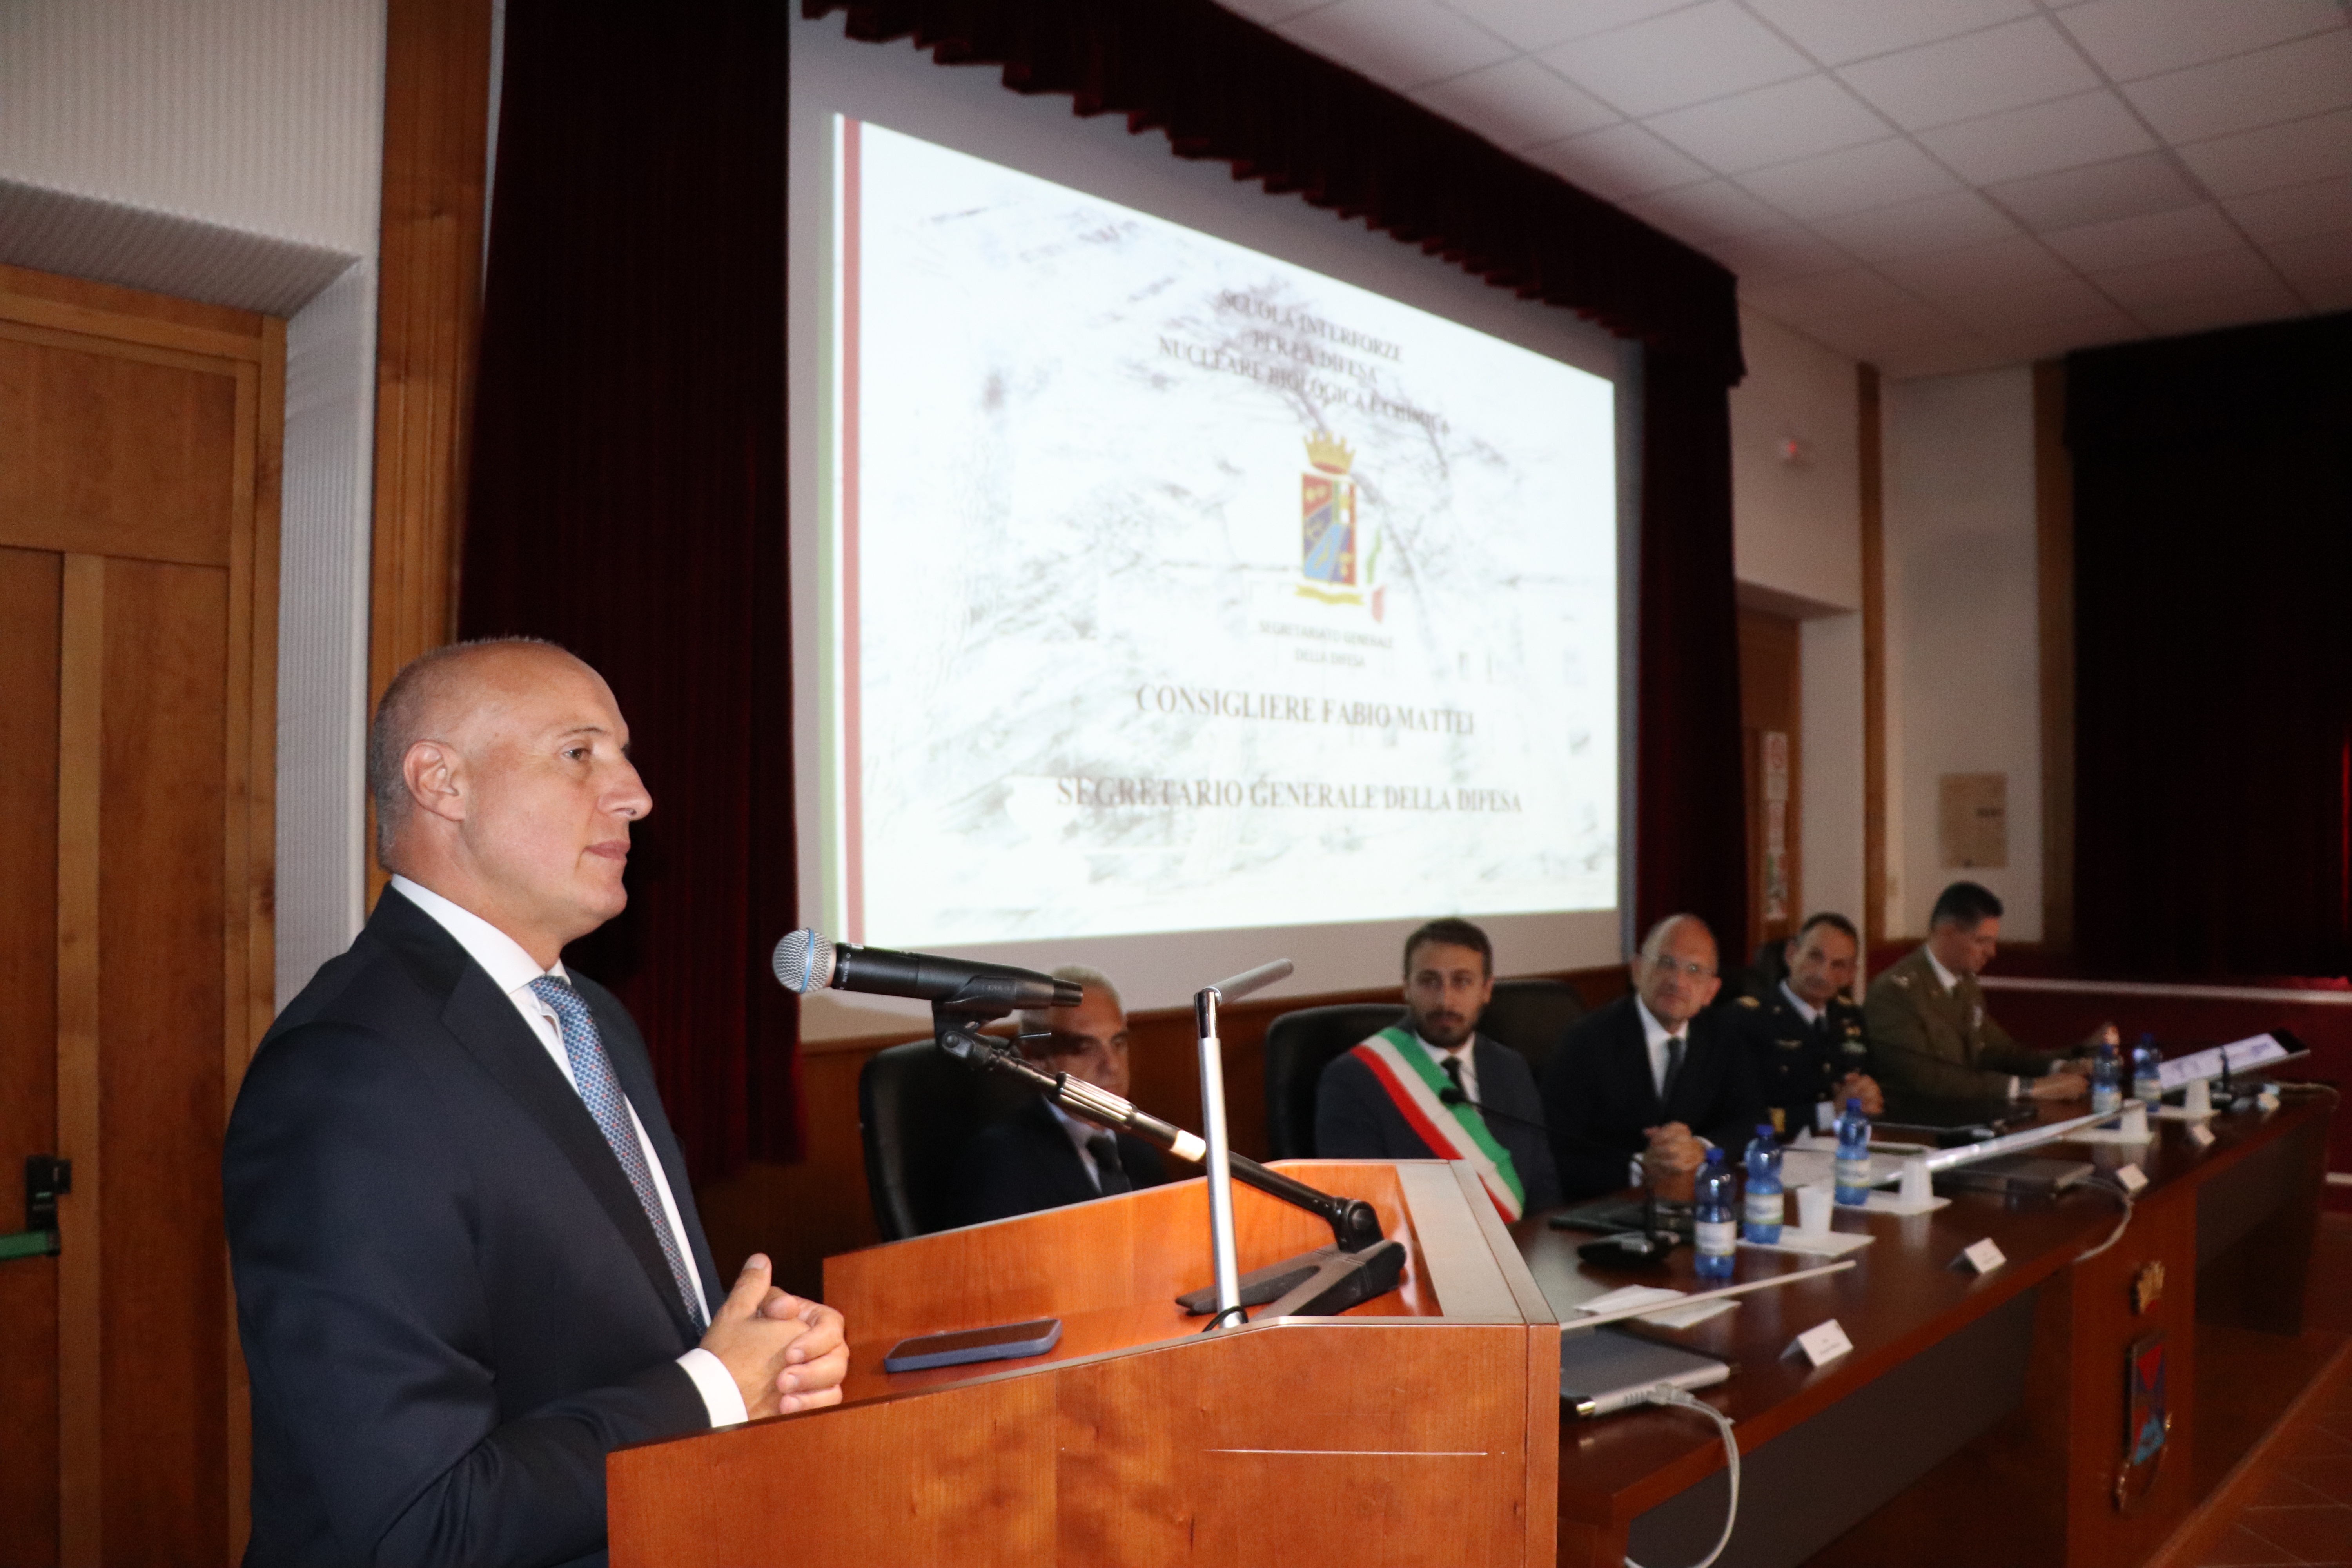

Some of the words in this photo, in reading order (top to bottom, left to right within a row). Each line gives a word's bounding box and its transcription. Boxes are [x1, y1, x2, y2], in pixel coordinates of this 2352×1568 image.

[1222, 291, 1294, 326] SCUOLA
[1300, 313, 1401, 361] INTERFORZE
[1319, 351, 1377, 383] DIFESA
[1159, 338, 1260, 380] NUCLEARE
[1267, 368, 1367, 412] BIOLOGICA
[1383, 403, 1450, 435] CHIMICA
[1260, 619, 1340, 642] SEGRETARIATO
[1343, 630, 1394, 649] GENERALE
[1296, 646, 1327, 662] DELLA
[1330, 652, 1365, 666] DIFESA
[1136, 683, 1316, 723] CONSIGLIERE
[1323, 699, 1390, 728] FABIO
[1397, 705, 1474, 734] MATTEI
[1058, 777, 1243, 807] SEGRETARIO
[1250, 779, 1377, 809] GENERALE
[1385, 785, 1451, 811] DELLA
[1457, 788, 1523, 813] DIFESA
